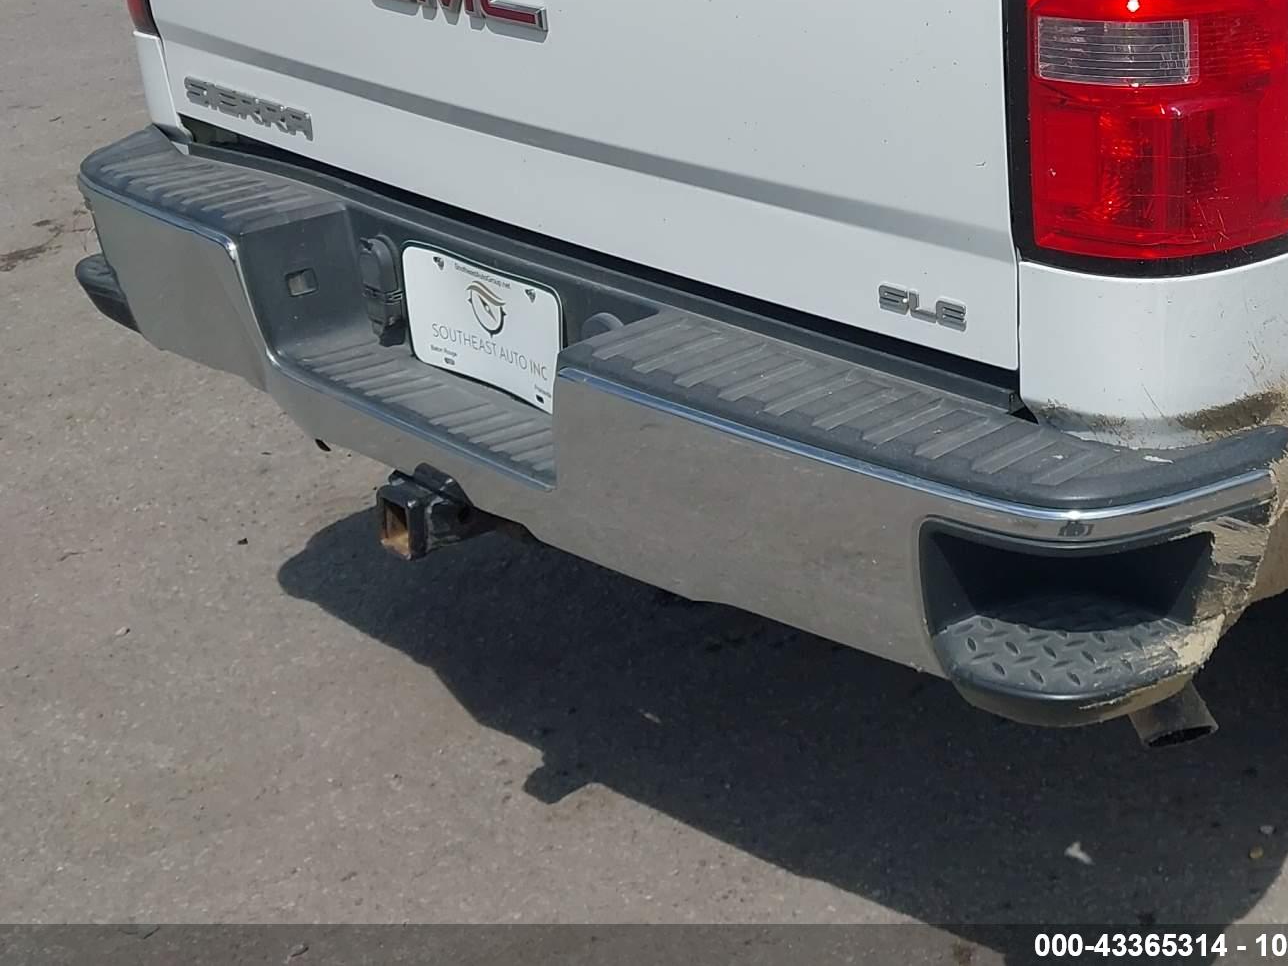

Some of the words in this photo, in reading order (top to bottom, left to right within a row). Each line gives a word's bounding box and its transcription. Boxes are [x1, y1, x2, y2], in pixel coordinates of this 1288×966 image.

[184, 76, 314, 142] SIERRA
[878, 284, 967, 332] SLE
[431, 323, 499, 356] SOUTHEAST
[499, 347, 528, 371] AUTO
[529, 359, 548, 381] INC
